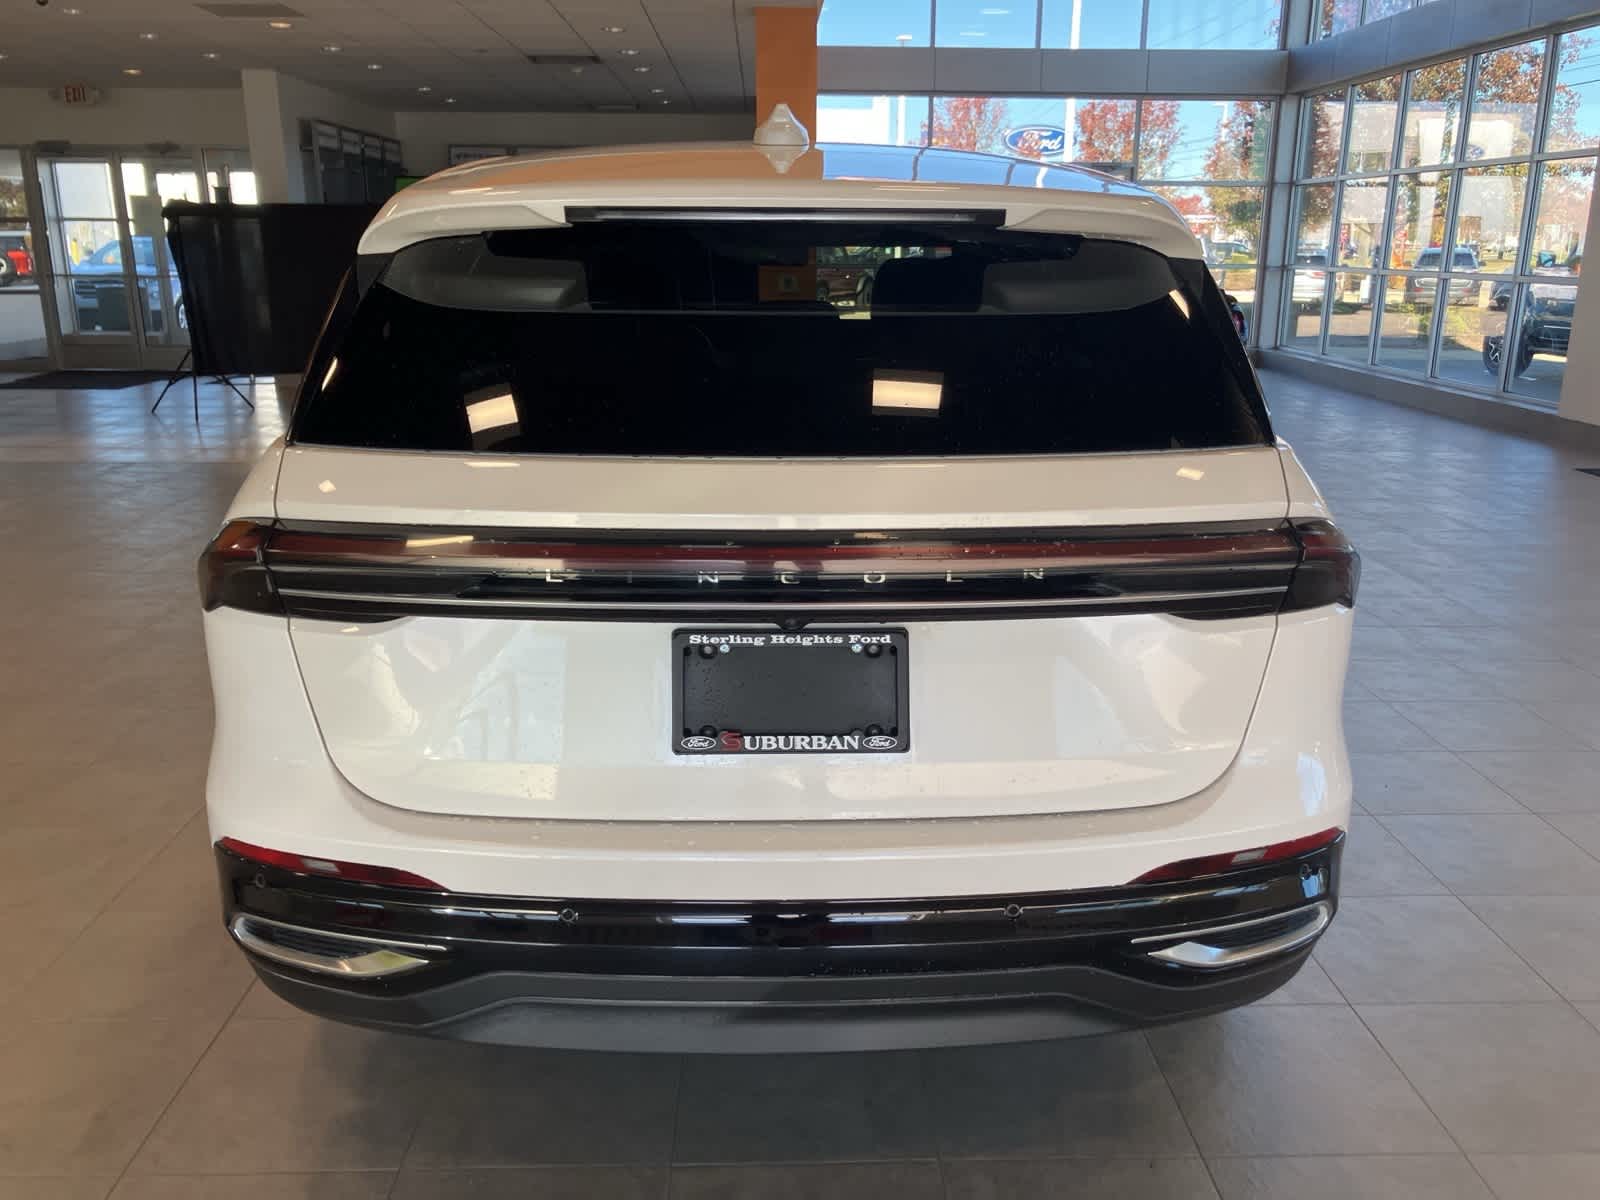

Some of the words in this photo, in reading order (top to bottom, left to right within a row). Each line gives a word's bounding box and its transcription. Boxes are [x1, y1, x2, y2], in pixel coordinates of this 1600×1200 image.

[1016, 130, 1064, 151] Ford
[689, 634, 766, 646] Sterling
[770, 634, 844, 646] Heights
[848, 634, 892, 644] Ford
[719, 731, 860, 751] SUBURBAN
